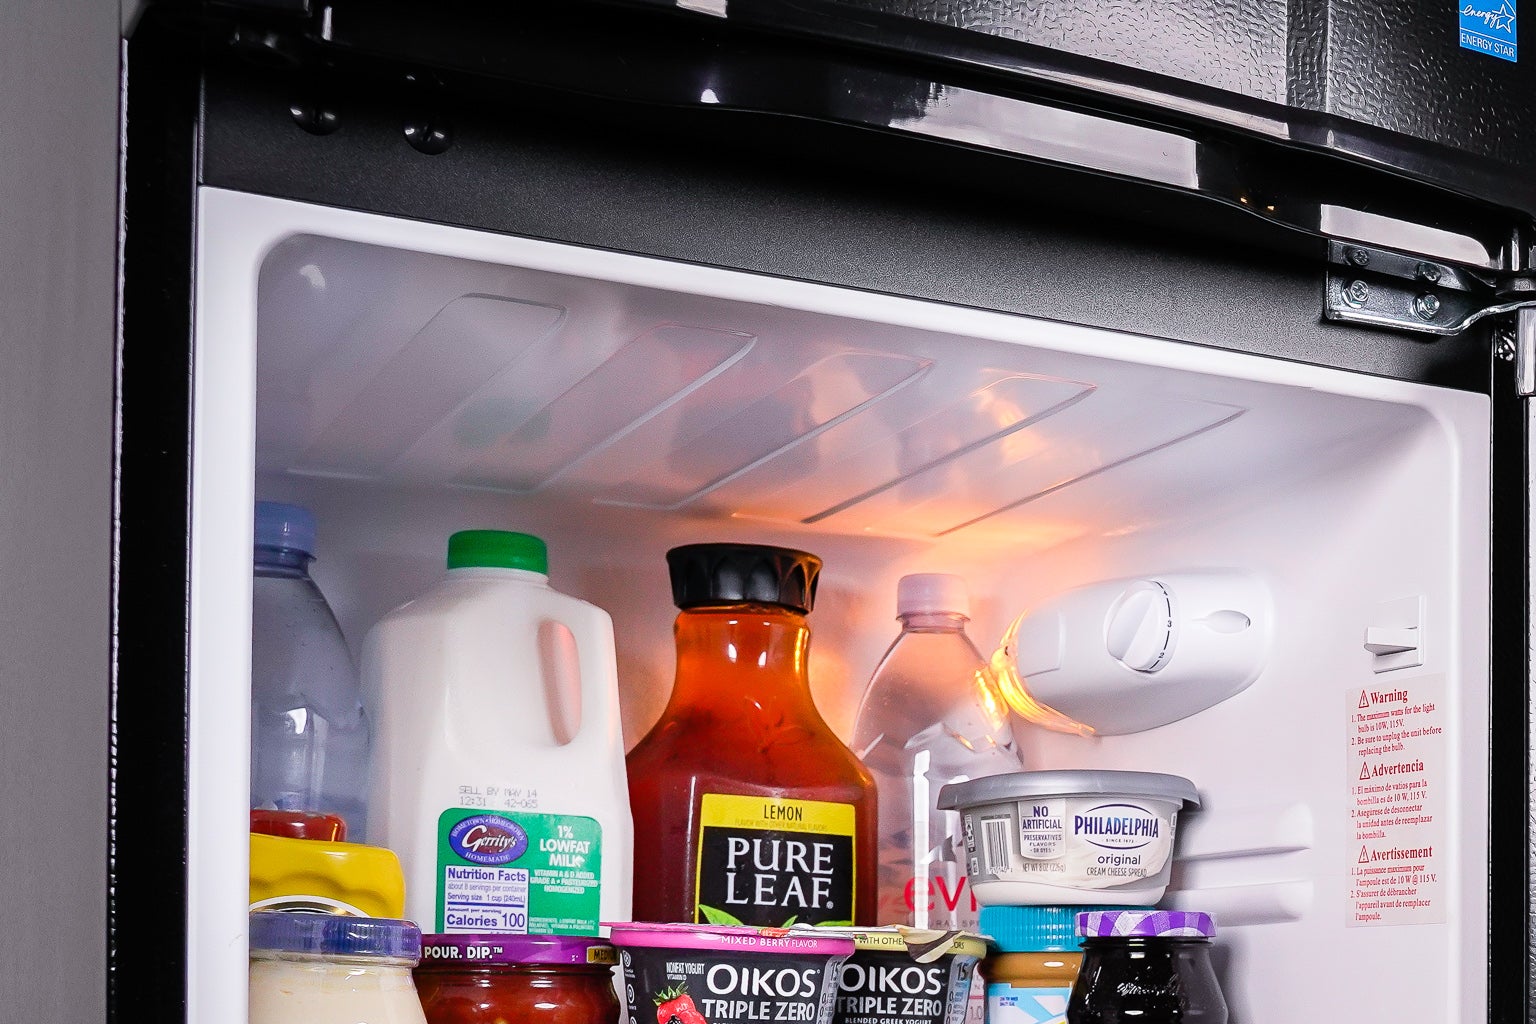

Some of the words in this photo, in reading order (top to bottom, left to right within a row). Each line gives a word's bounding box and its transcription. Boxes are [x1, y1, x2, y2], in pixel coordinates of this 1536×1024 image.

[1463, 5, 1500, 28] energy
[1461, 33, 1492, 50] ENERGY
[1494, 44, 1515, 57] STAR
[1370, 689, 1408, 704] Warning
[1359, 745, 1382, 757] replacing
[1392, 743, 1405, 751] bulb.
[1372, 759, 1424, 777] Advertencia
[764, 804, 802, 821] LEMON
[1033, 806, 1049, 817] NO
[557, 825, 573, 838] 1%
[1023, 819, 1062, 829] ARTIFICIAL
[1074, 815, 1159, 838] PHILADELPHIA
[462, 825, 517, 852] Gerrity's
[540, 839, 590, 854] LOWFAT
[1371, 846, 1433, 861] Avertissement
[727, 837, 834, 875] PURE
[1097, 854, 1141, 866] original
[448, 868, 495, 880] Nutrition
[498, 870, 526, 881] Facts
[1086, 867, 1106, 876] CREAM
[1107, 867, 1127, 876] CHEESE
[1128, 867, 1147, 877] SPREAD
[726, 872, 831, 908] LEAF
[447, 914, 497, 927] Calories
[502, 913, 525, 927] 100
[721, 936, 757, 946] MIXED
[760, 937, 790, 947] BERRY
[791, 939, 818, 948] FLAVOR
[424, 946, 462, 959] POUR.
[706, 963, 816, 998] OIKOS
[840, 964, 942, 995] OIKOS
[701, 998, 770, 1020] TRIPLE
[774, 1001, 815, 1021] ZERO
